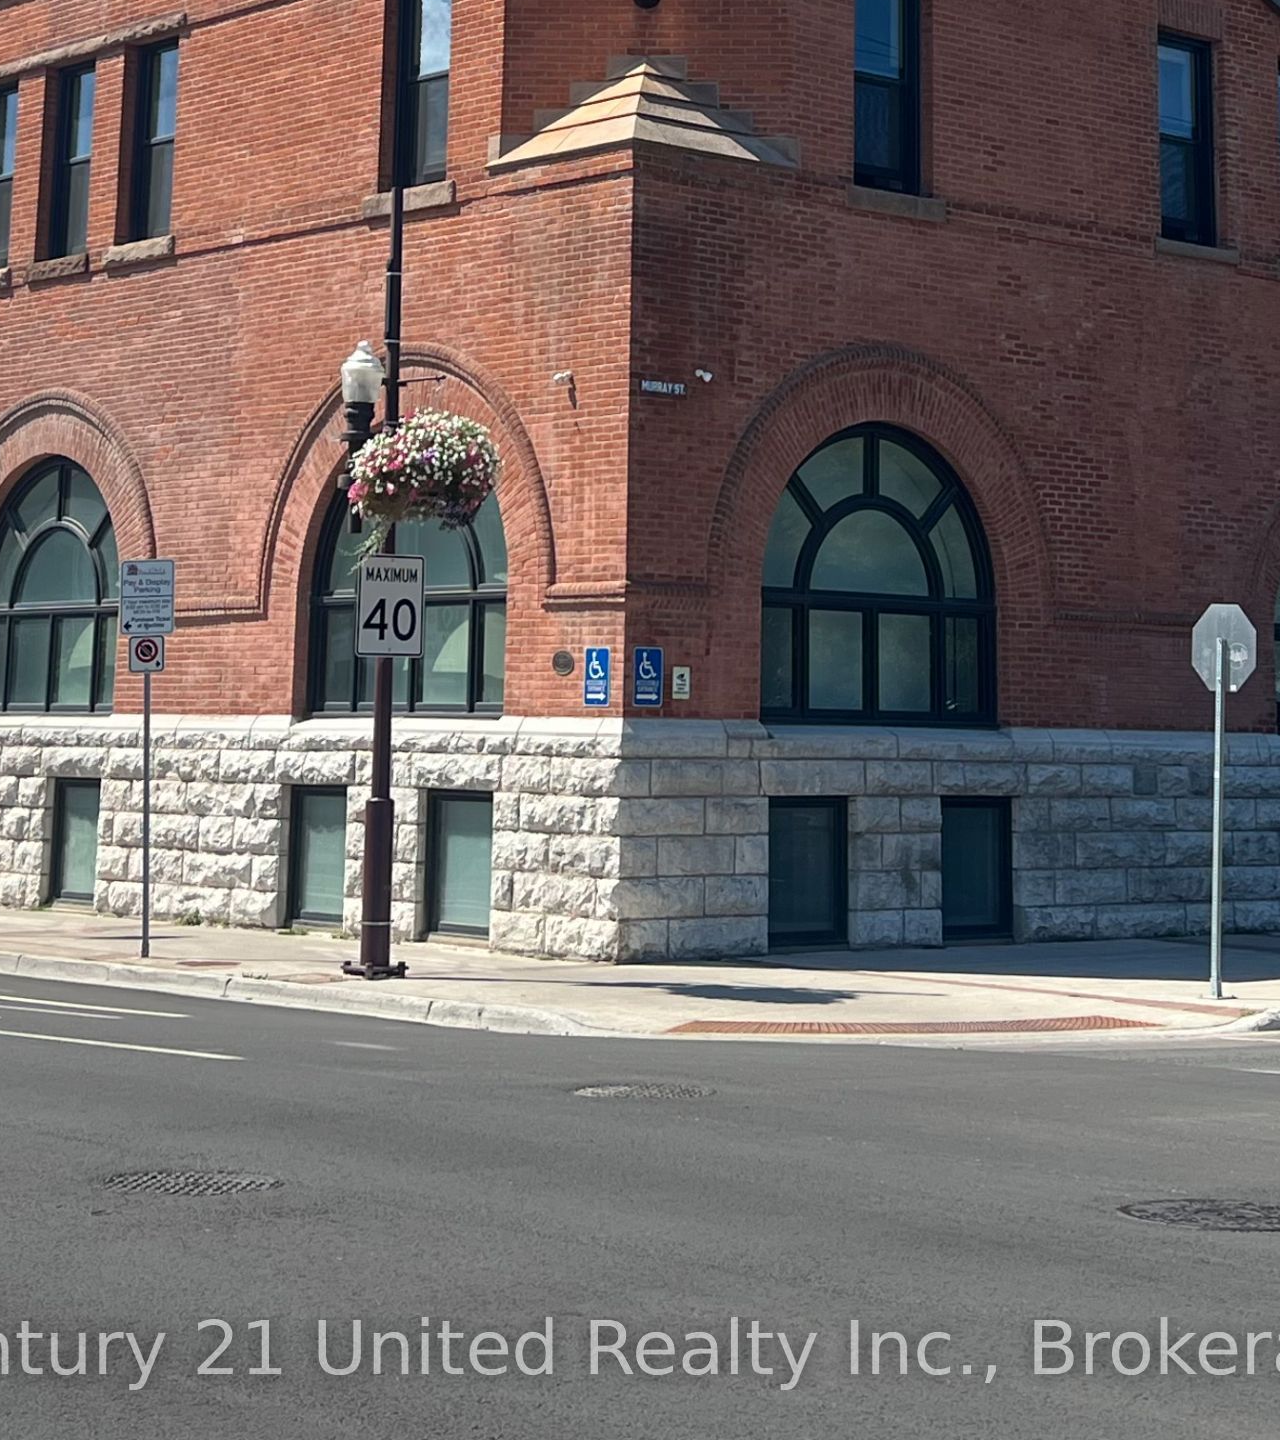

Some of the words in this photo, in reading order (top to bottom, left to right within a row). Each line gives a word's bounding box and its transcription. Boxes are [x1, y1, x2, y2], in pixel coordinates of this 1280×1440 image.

[641, 380, 673, 394] MURRAY
[366, 566, 418, 583] MAXIMUM
[362, 598, 417, 641] 40
